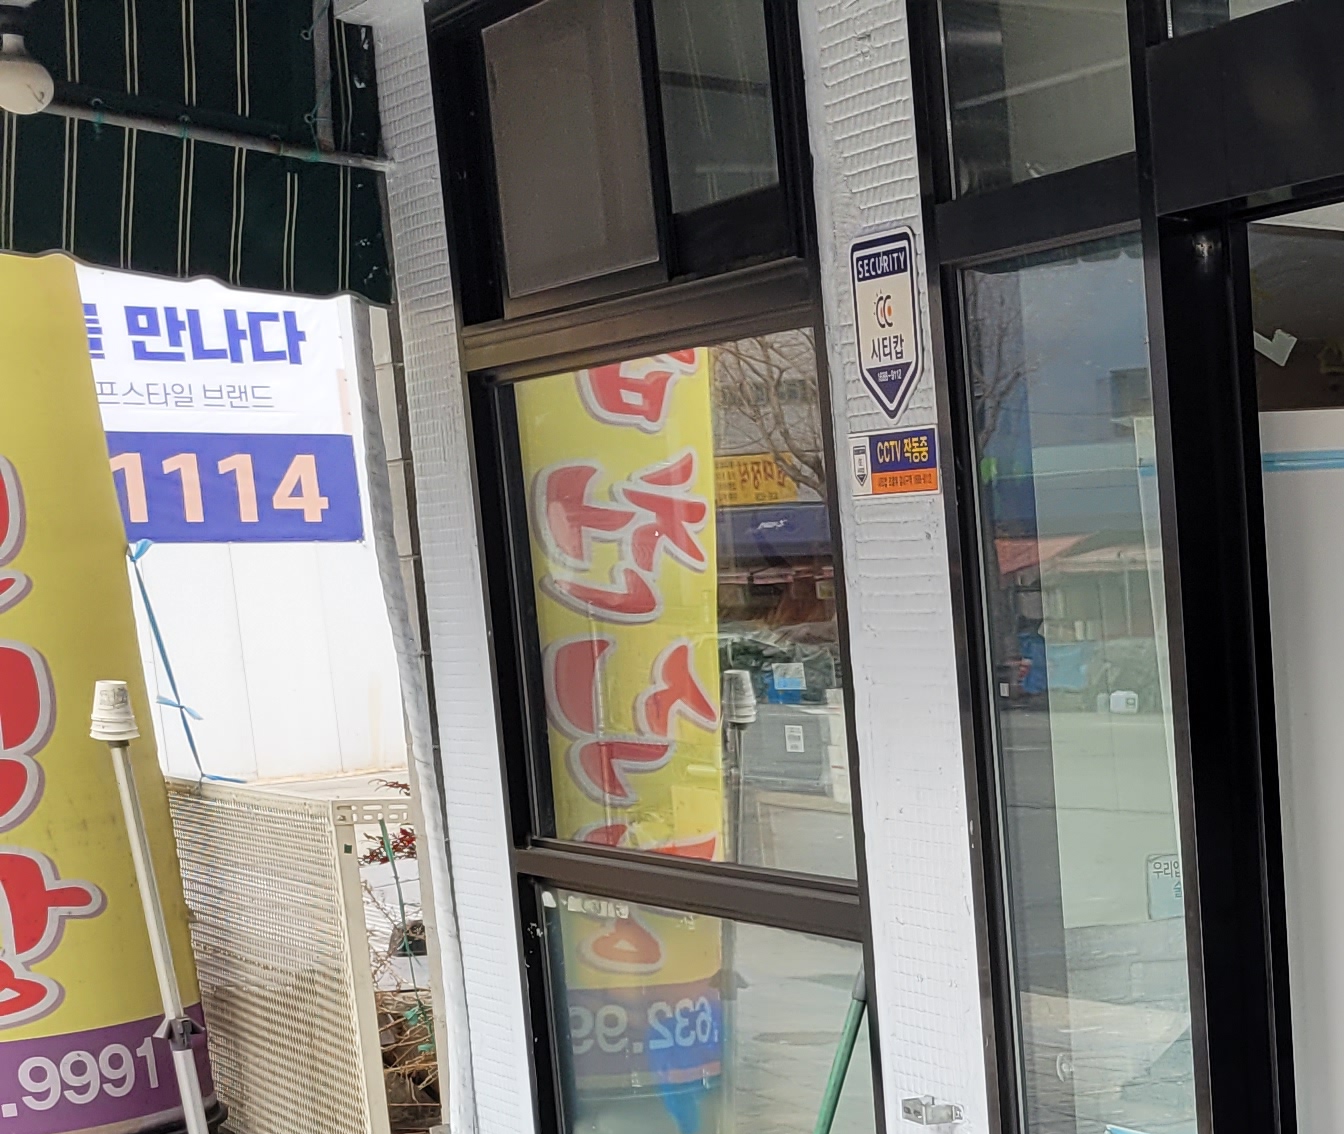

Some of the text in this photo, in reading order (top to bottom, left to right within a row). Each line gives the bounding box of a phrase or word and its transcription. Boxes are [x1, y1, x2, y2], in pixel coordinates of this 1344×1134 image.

[857, 250, 906, 279] SECURITY
[123, 304, 308, 365] 만나다
[870, 333, 905, 363] 시티캅
[201, 383, 276, 409] 브랜드
[876, 435, 929, 464] CCTV 작동중
[110, 452, 330, 524] 1114
